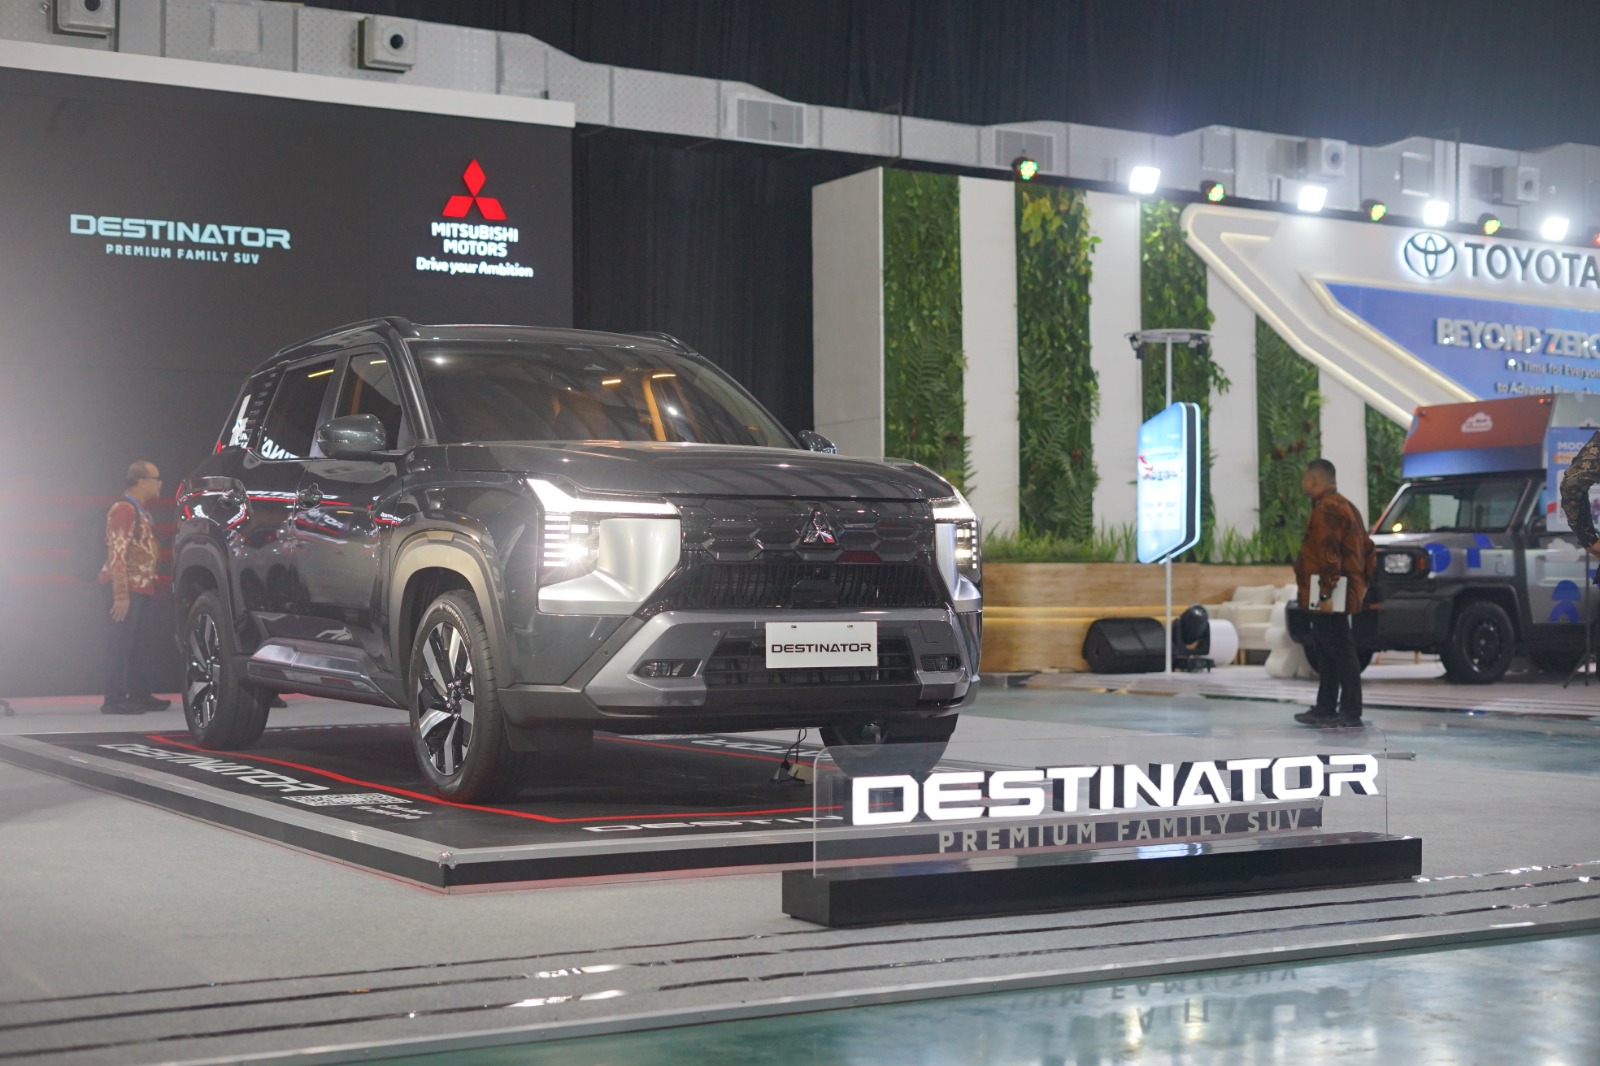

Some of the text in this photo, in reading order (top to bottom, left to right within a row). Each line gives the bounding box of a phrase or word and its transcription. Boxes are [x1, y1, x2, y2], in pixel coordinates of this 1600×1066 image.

[70, 214, 291, 249] DESTINATOR
[431, 222, 519, 242] MITSUBISHI
[443, 239, 508, 257] MOTORS
[106, 244, 260, 264] PREMIUM FAMILY SUV
[416, 256, 534, 277] Drive your Ambition
[1464, 242, 1600, 288] TOYOTA
[1436, 317, 1542, 353] BEYOND
[771, 643, 872, 653] DESTINATOR
[96, 743, 330, 793] DESTINATOR
[850, 754, 1380, 827] DESTINATOR
[939, 808, 1302, 854] PREMIUM FAMILY SUV
